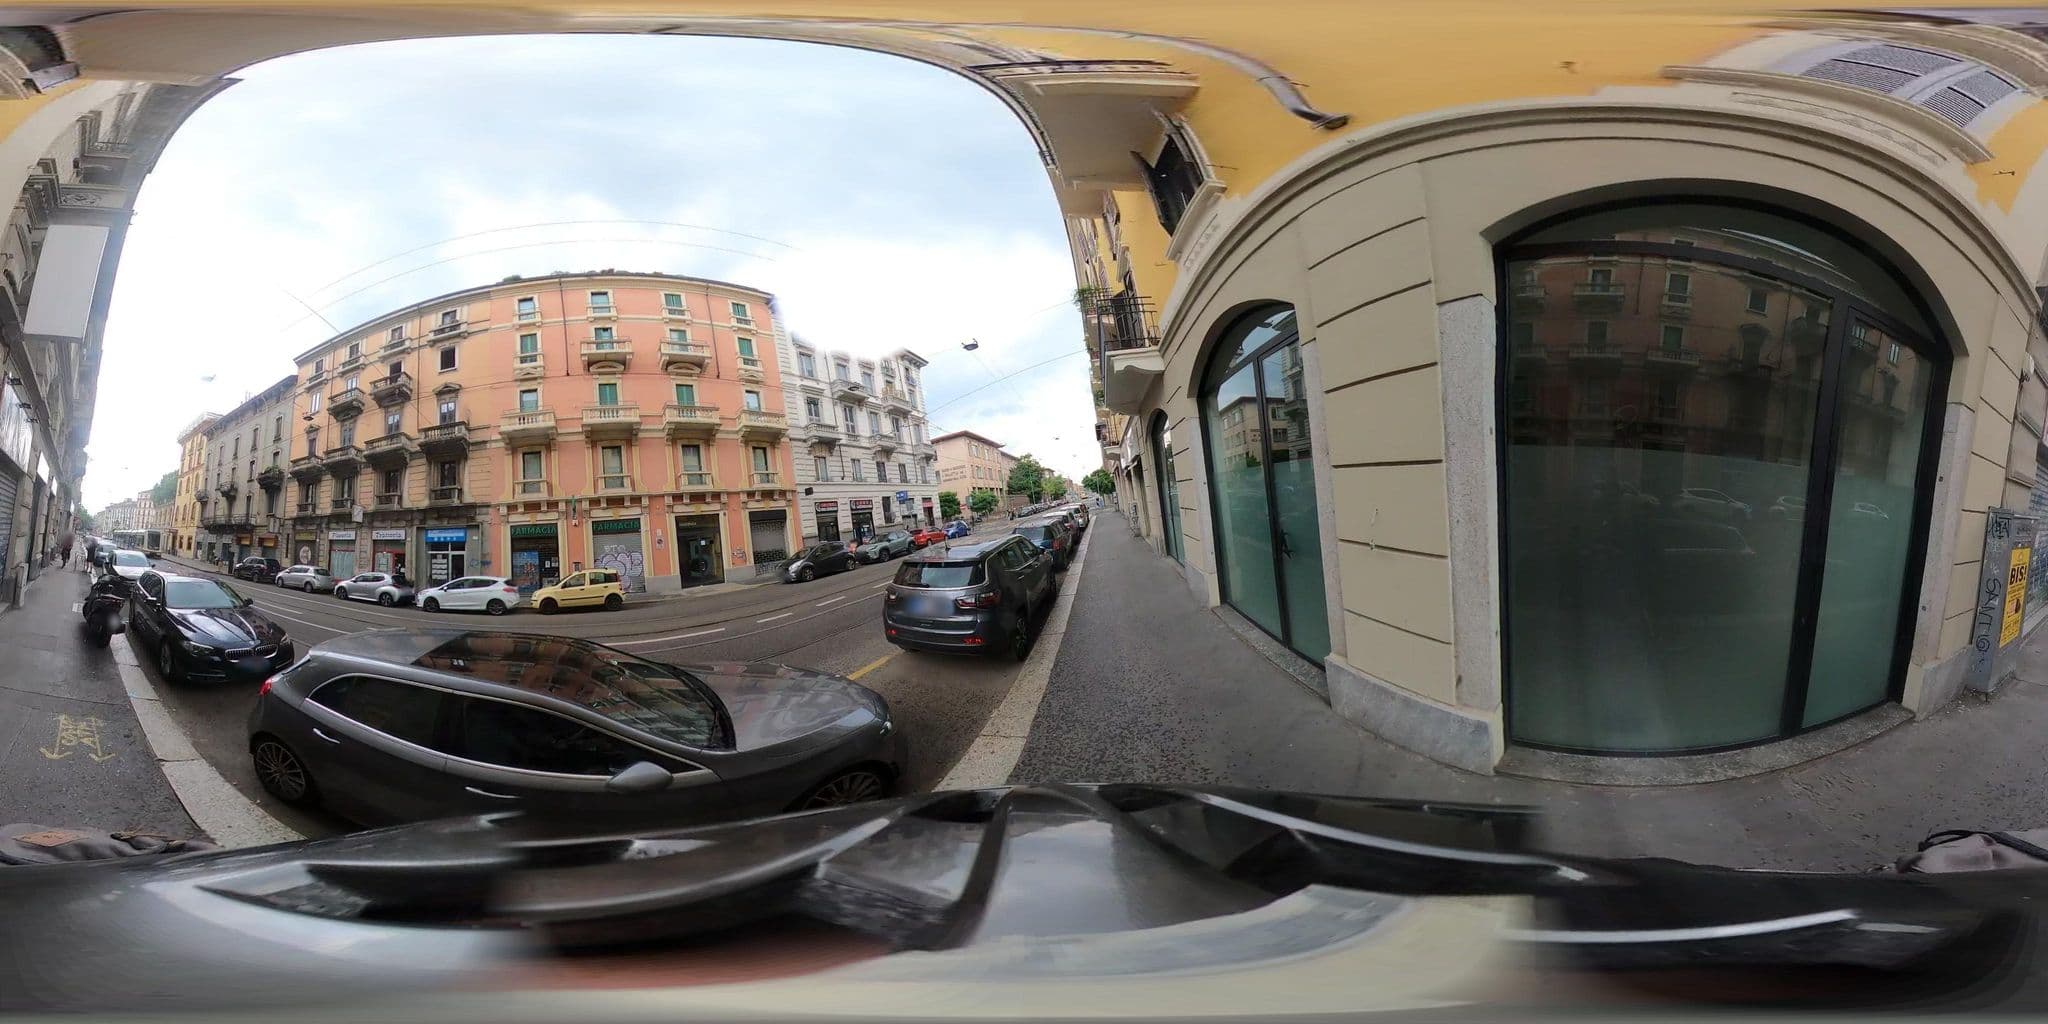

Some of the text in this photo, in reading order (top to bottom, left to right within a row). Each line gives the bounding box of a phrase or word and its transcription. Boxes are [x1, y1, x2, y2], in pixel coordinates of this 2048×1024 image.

[511, 526, 556, 536] FARMACIA
[593, 520, 640, 531] FARMACIA
[2009, 565, 2028, 586] BIS!
